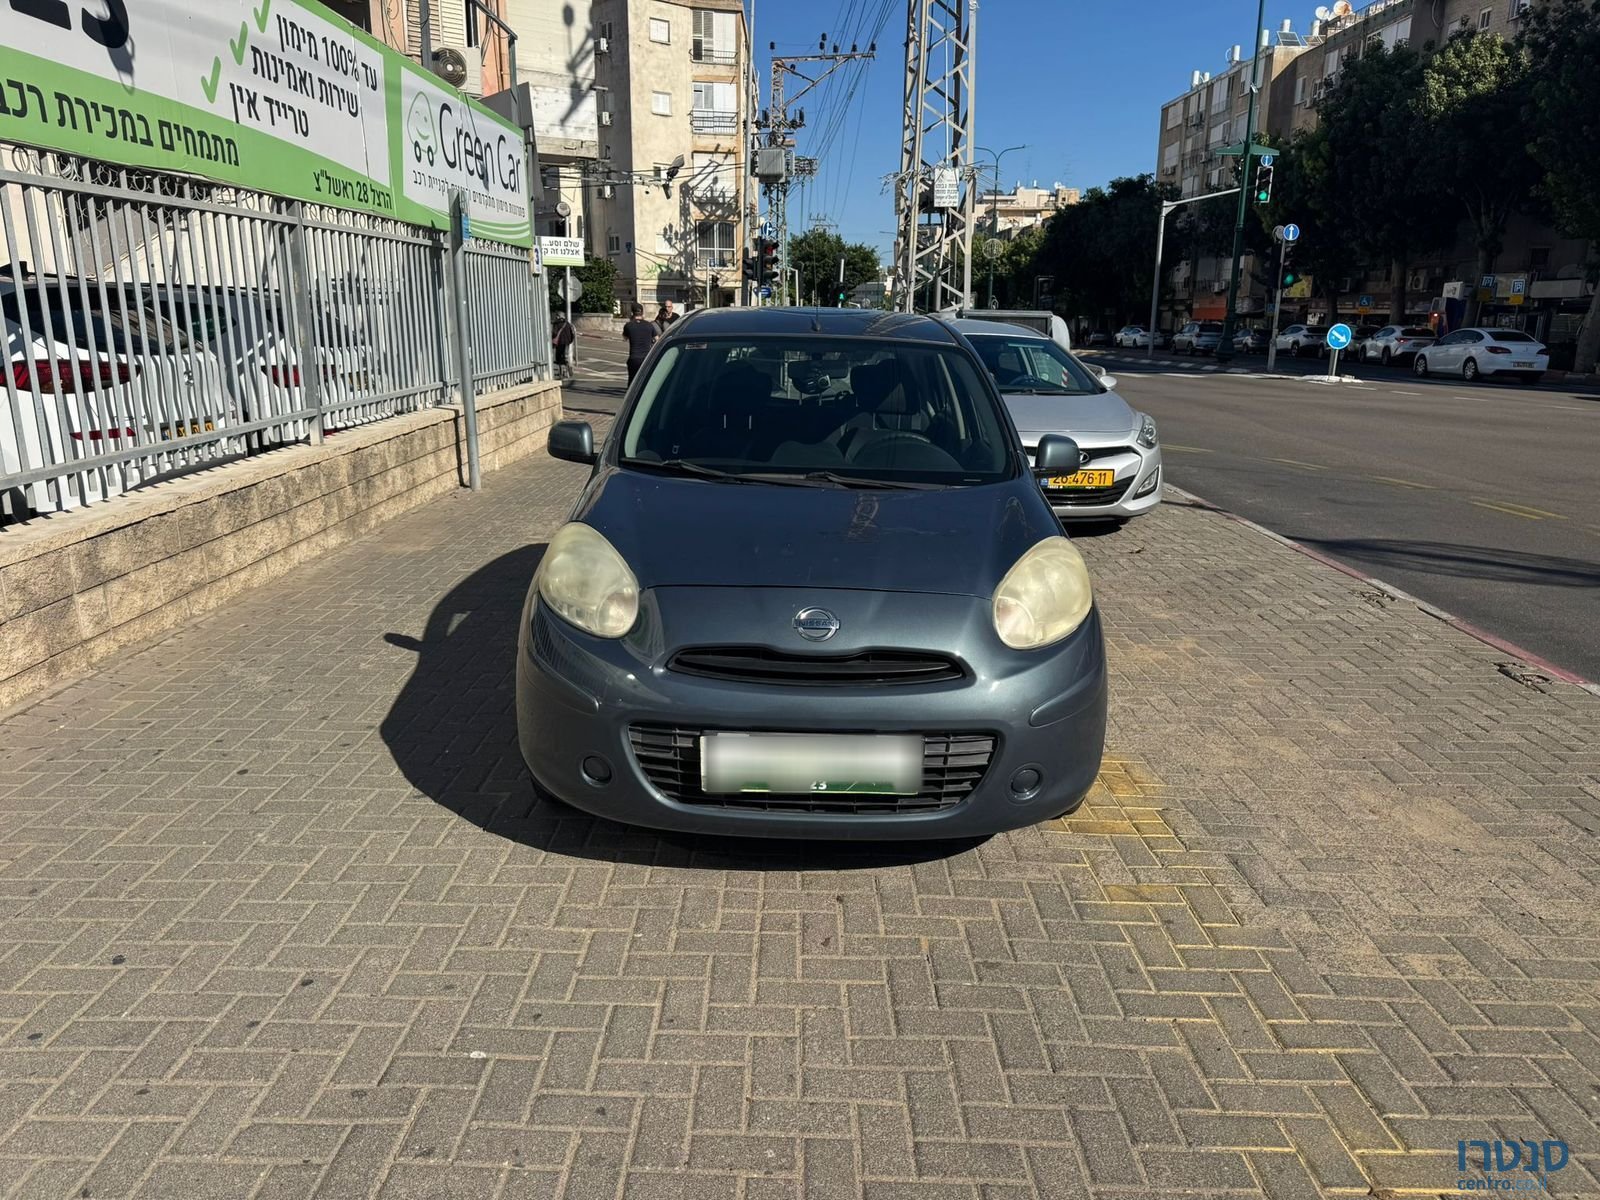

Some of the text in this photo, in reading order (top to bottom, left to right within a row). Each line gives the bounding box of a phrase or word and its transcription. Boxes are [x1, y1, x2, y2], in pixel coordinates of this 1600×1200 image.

[276, 14, 377, 91] עד 100% מימון
[251, 45, 359, 117] שירות ואמינות
[54, 91, 154, 147] במכירת
[229, 82, 309, 137] טרייד אין
[158, 119, 240, 167] מתמחים
[439, 102, 521, 194] Green Car
[356, 180, 369, 203] 28
[370, 183, 392, 210] הרצל
[413, 170, 426, 187] רכב
[560, 248, 580, 256] אצלנו
[564, 240, 580, 248] שלם
